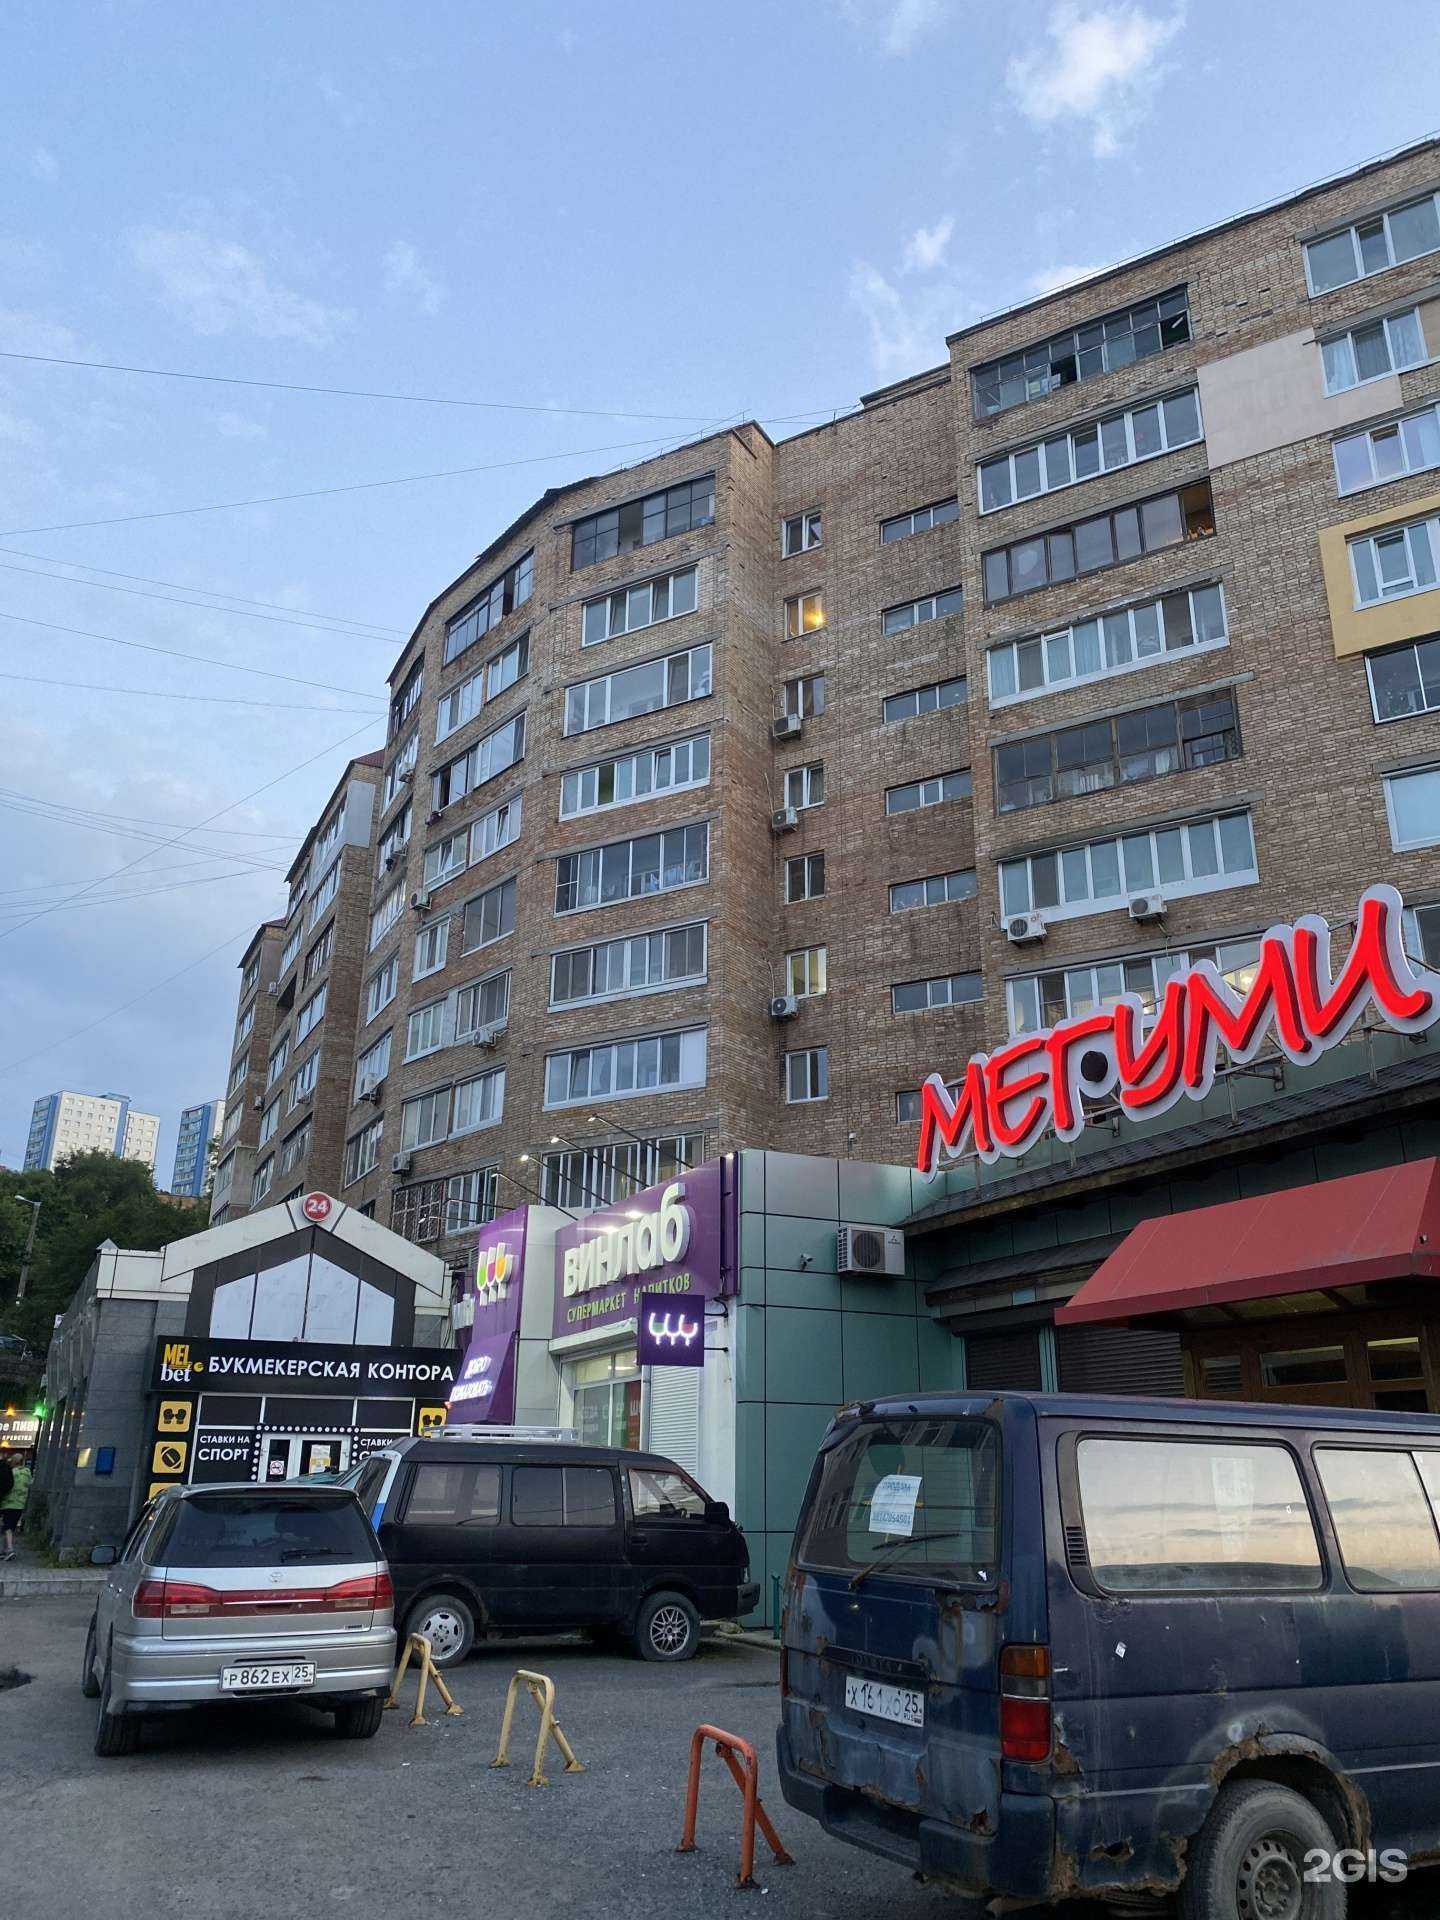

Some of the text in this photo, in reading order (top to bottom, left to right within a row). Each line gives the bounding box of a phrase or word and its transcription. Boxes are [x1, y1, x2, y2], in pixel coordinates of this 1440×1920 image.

[917, 898, 1433, 1173] МЕГУМИ
[307, 1199, 328, 1213] 24
[567, 1292, 626, 1323] СУПЕРМАРКЕТ
[160, 1363, 192, 1382] bet
[208, 1356, 453, 1381] БУКМЕКЕРСКАЯ КОНТОРА
[200, 1435, 250, 1444] СТАВКИ НА
[198, 1448, 248, 1461] СПОРТ
